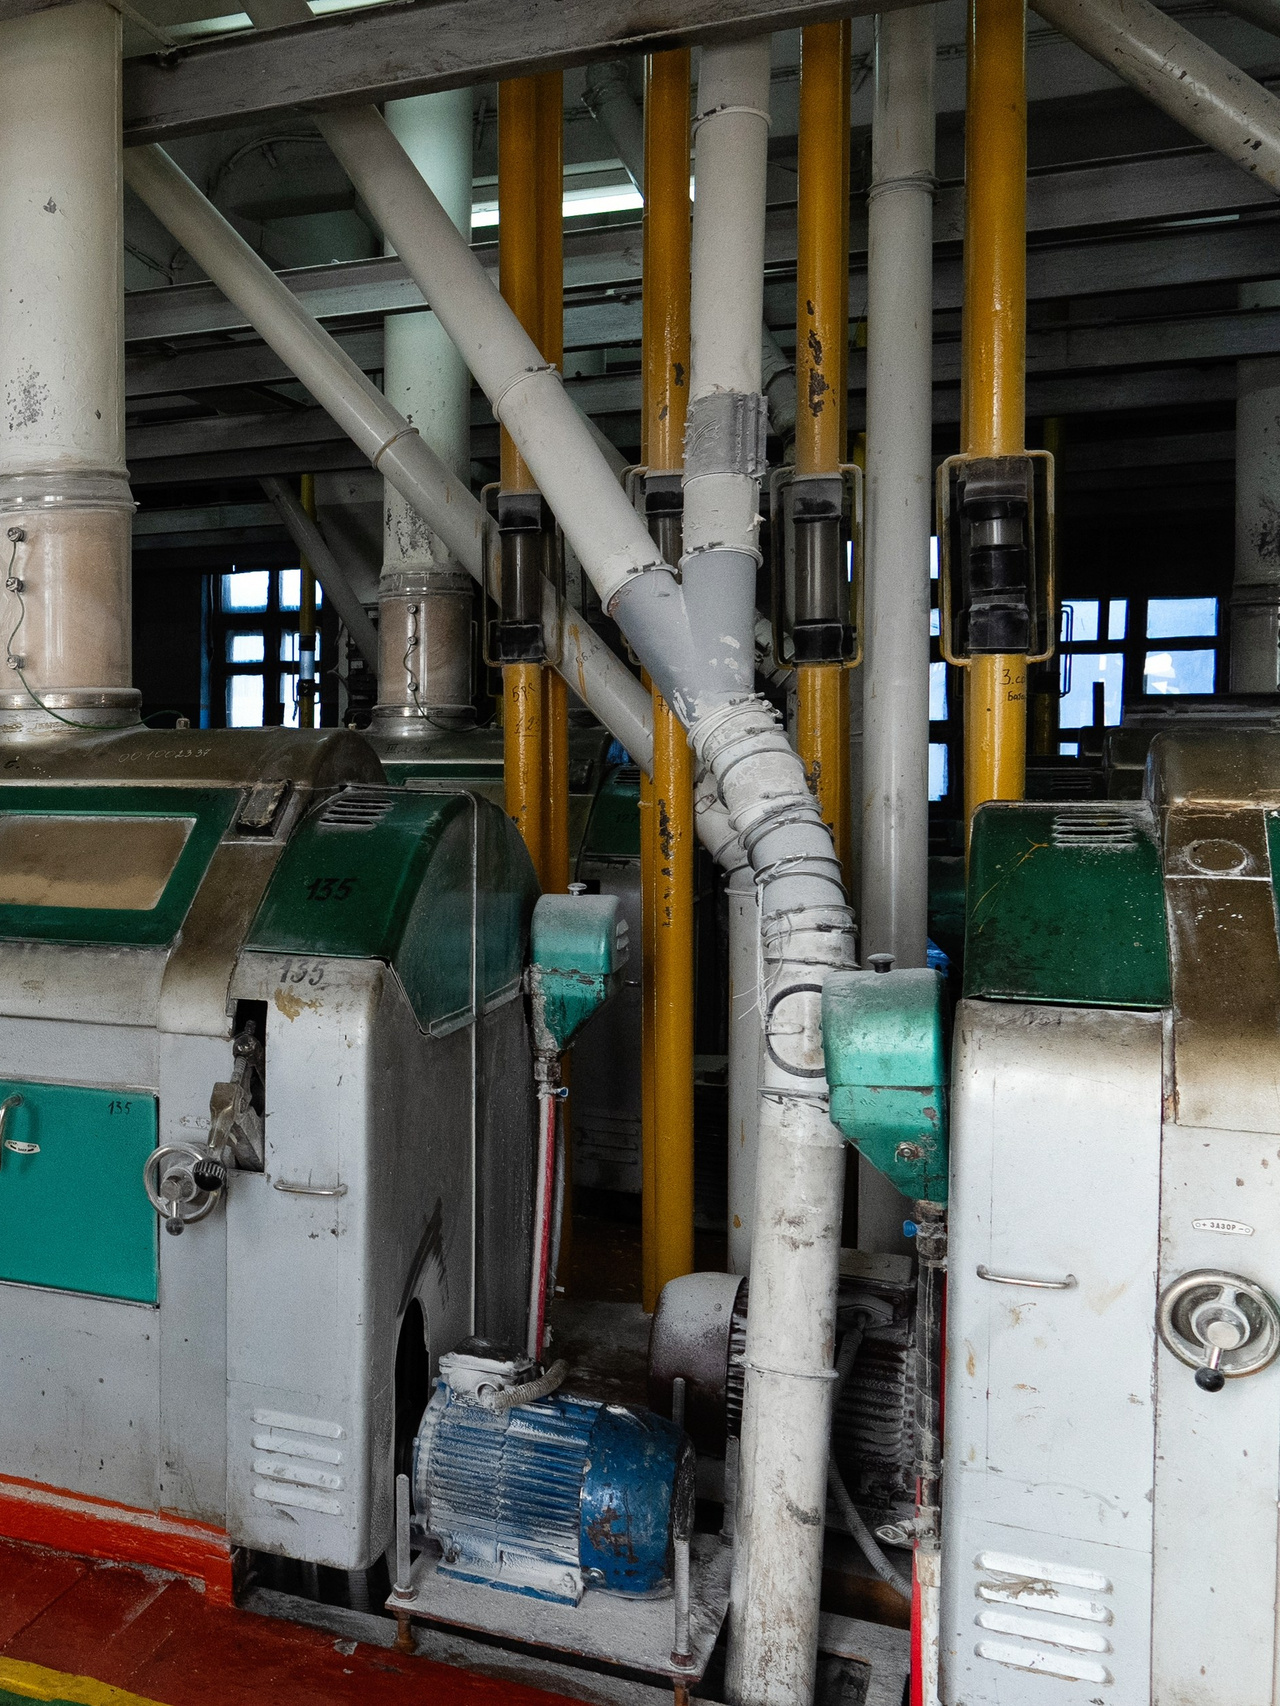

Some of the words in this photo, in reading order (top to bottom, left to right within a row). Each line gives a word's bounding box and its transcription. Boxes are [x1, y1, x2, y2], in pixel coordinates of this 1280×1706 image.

[306, 876, 357, 901] 135
[280, 959, 329, 986] 135
[108, 1101, 132, 1115] 135
[1210, 1222, 1236, 1230] ЗАЗОР
